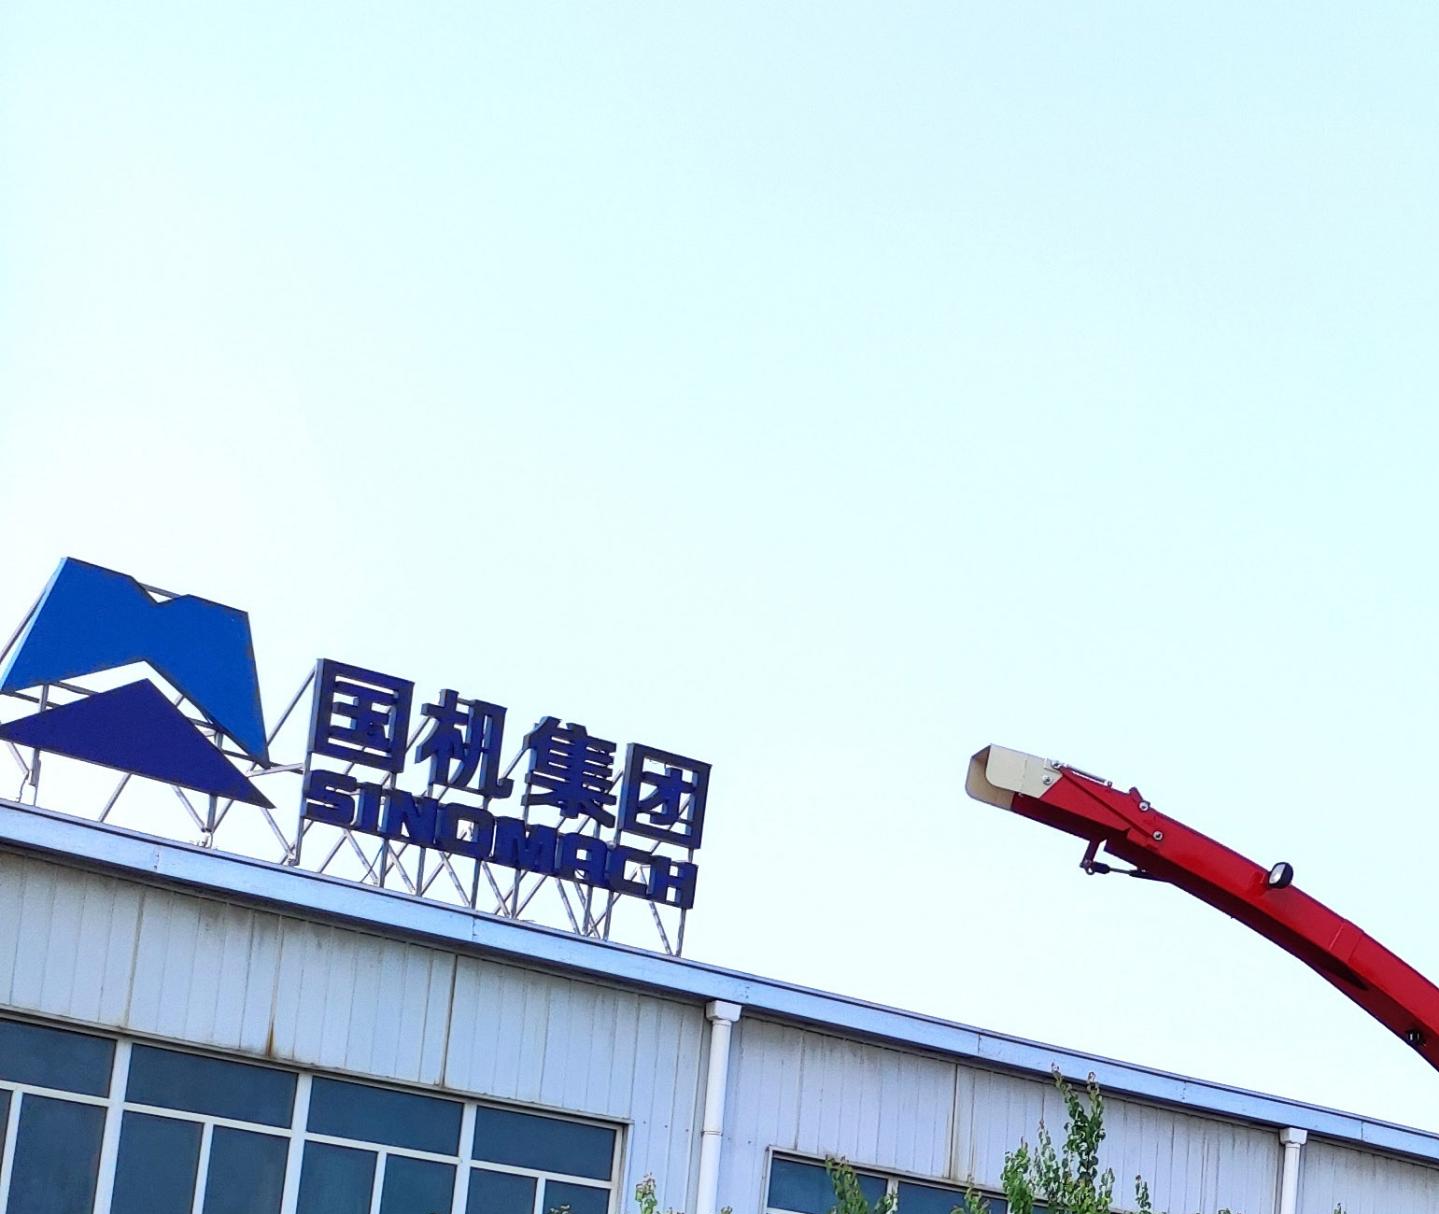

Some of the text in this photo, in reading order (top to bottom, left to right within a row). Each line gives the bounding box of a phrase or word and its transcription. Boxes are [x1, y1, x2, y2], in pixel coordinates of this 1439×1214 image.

[309, 658, 712, 849] 国机集团
[302, 769, 697, 910] SINOMACH
